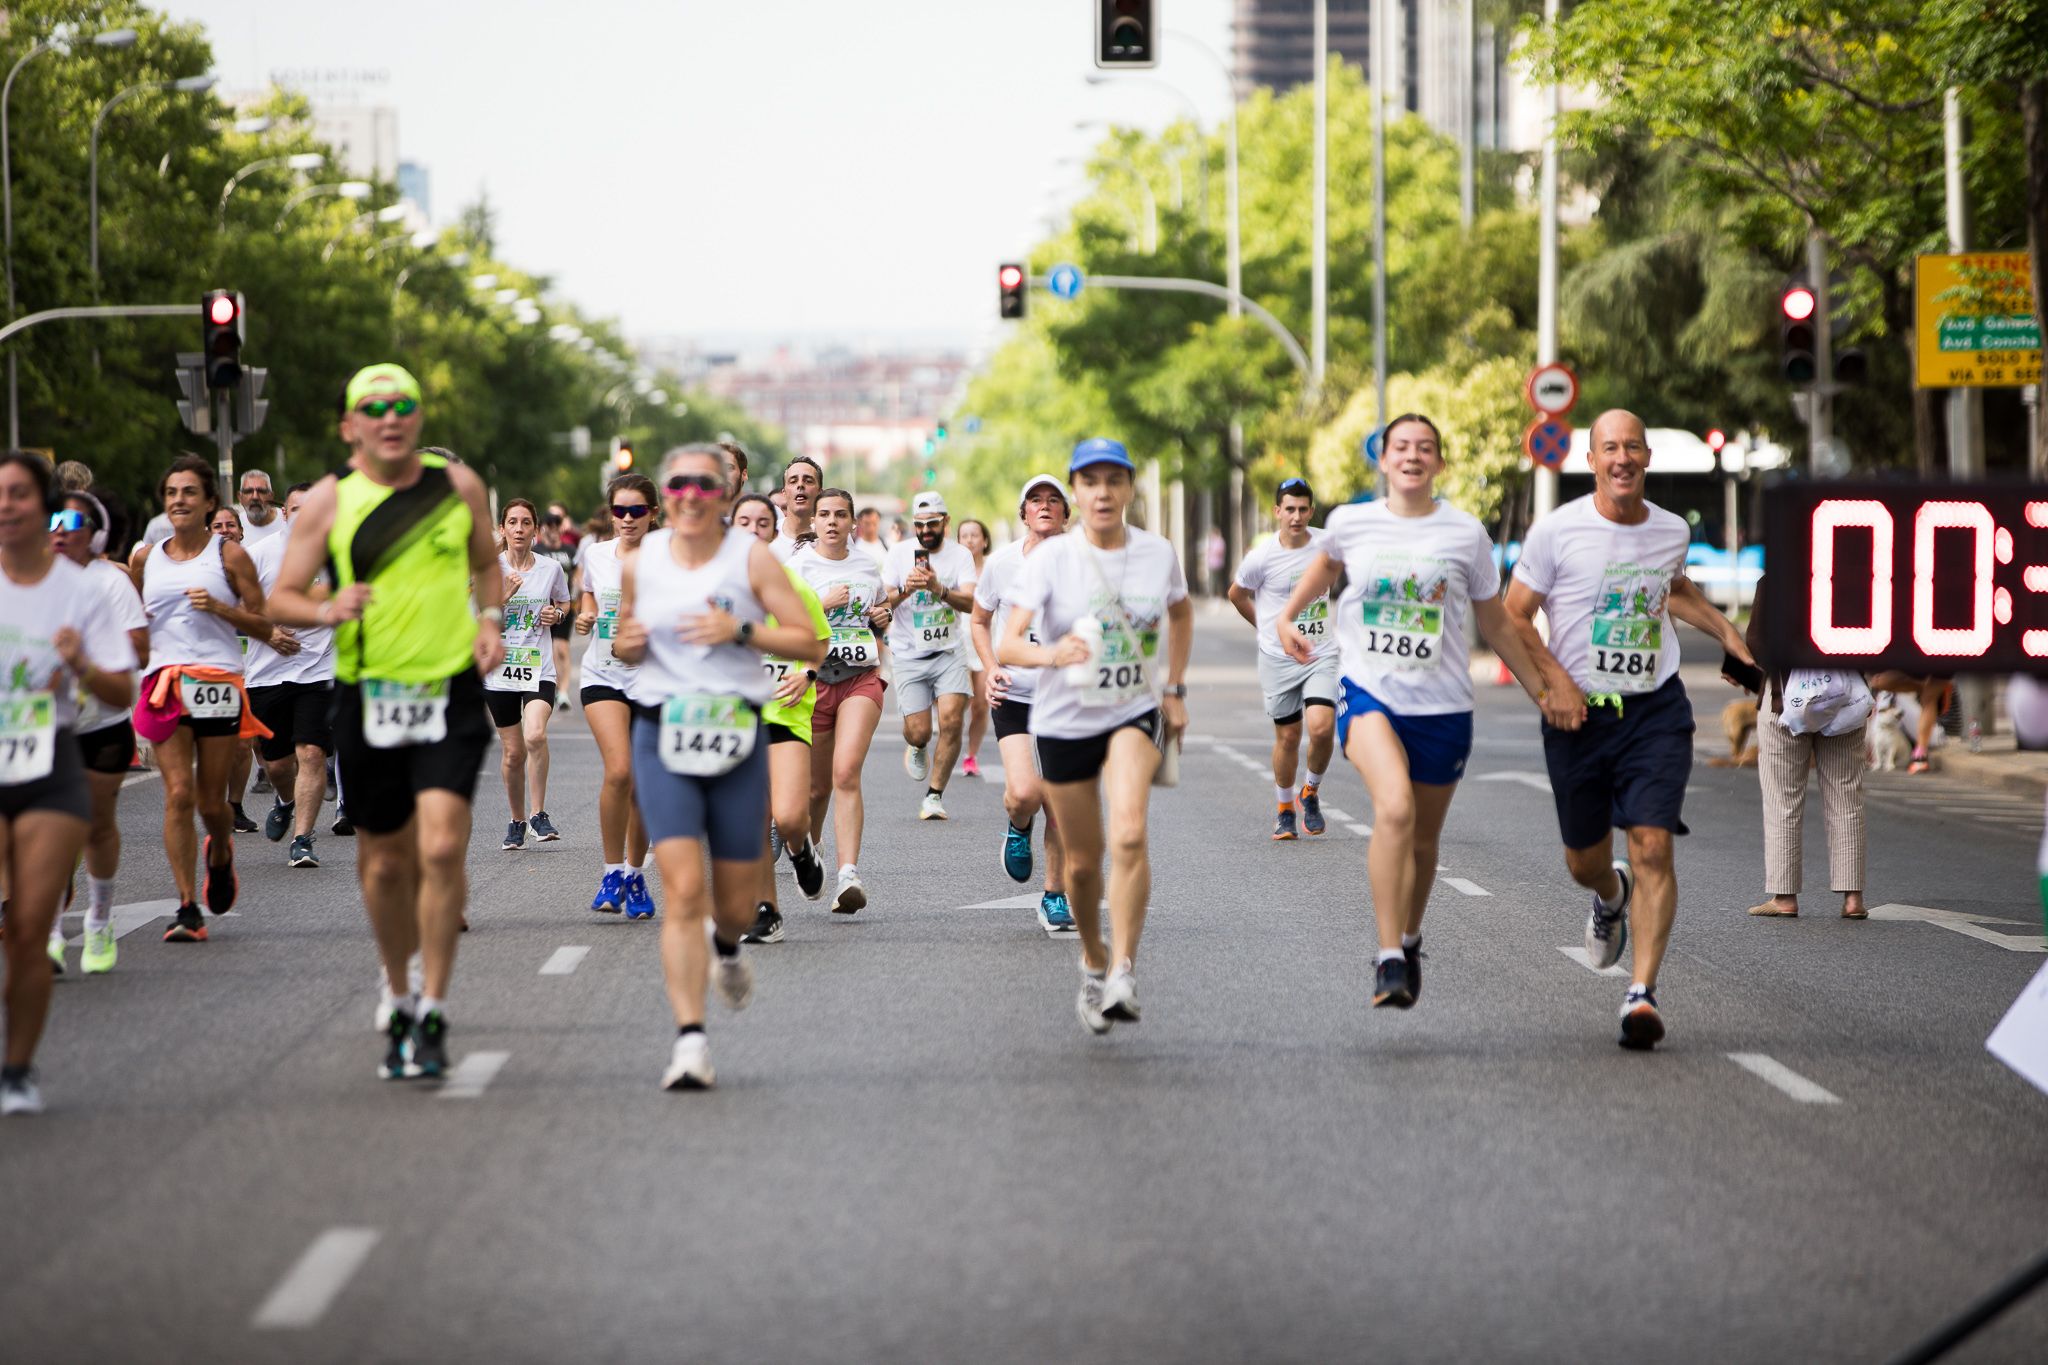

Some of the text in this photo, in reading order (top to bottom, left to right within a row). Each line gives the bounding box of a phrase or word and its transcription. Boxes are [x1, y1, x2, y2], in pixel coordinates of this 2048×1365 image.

[923, 626, 949, 641] 844
[1297, 621, 1324, 636] 843
[1607, 624, 1652, 647] ELA
[828, 645, 867, 662] 488
[1368, 631, 1432, 659] 1286
[502, 666, 533, 681] 445
[1596, 650, 1656, 676] 1284
[1099, 664, 1142, 689] 201
[193, 686, 232, 705] 604
[674, 729, 742, 757] 1442
